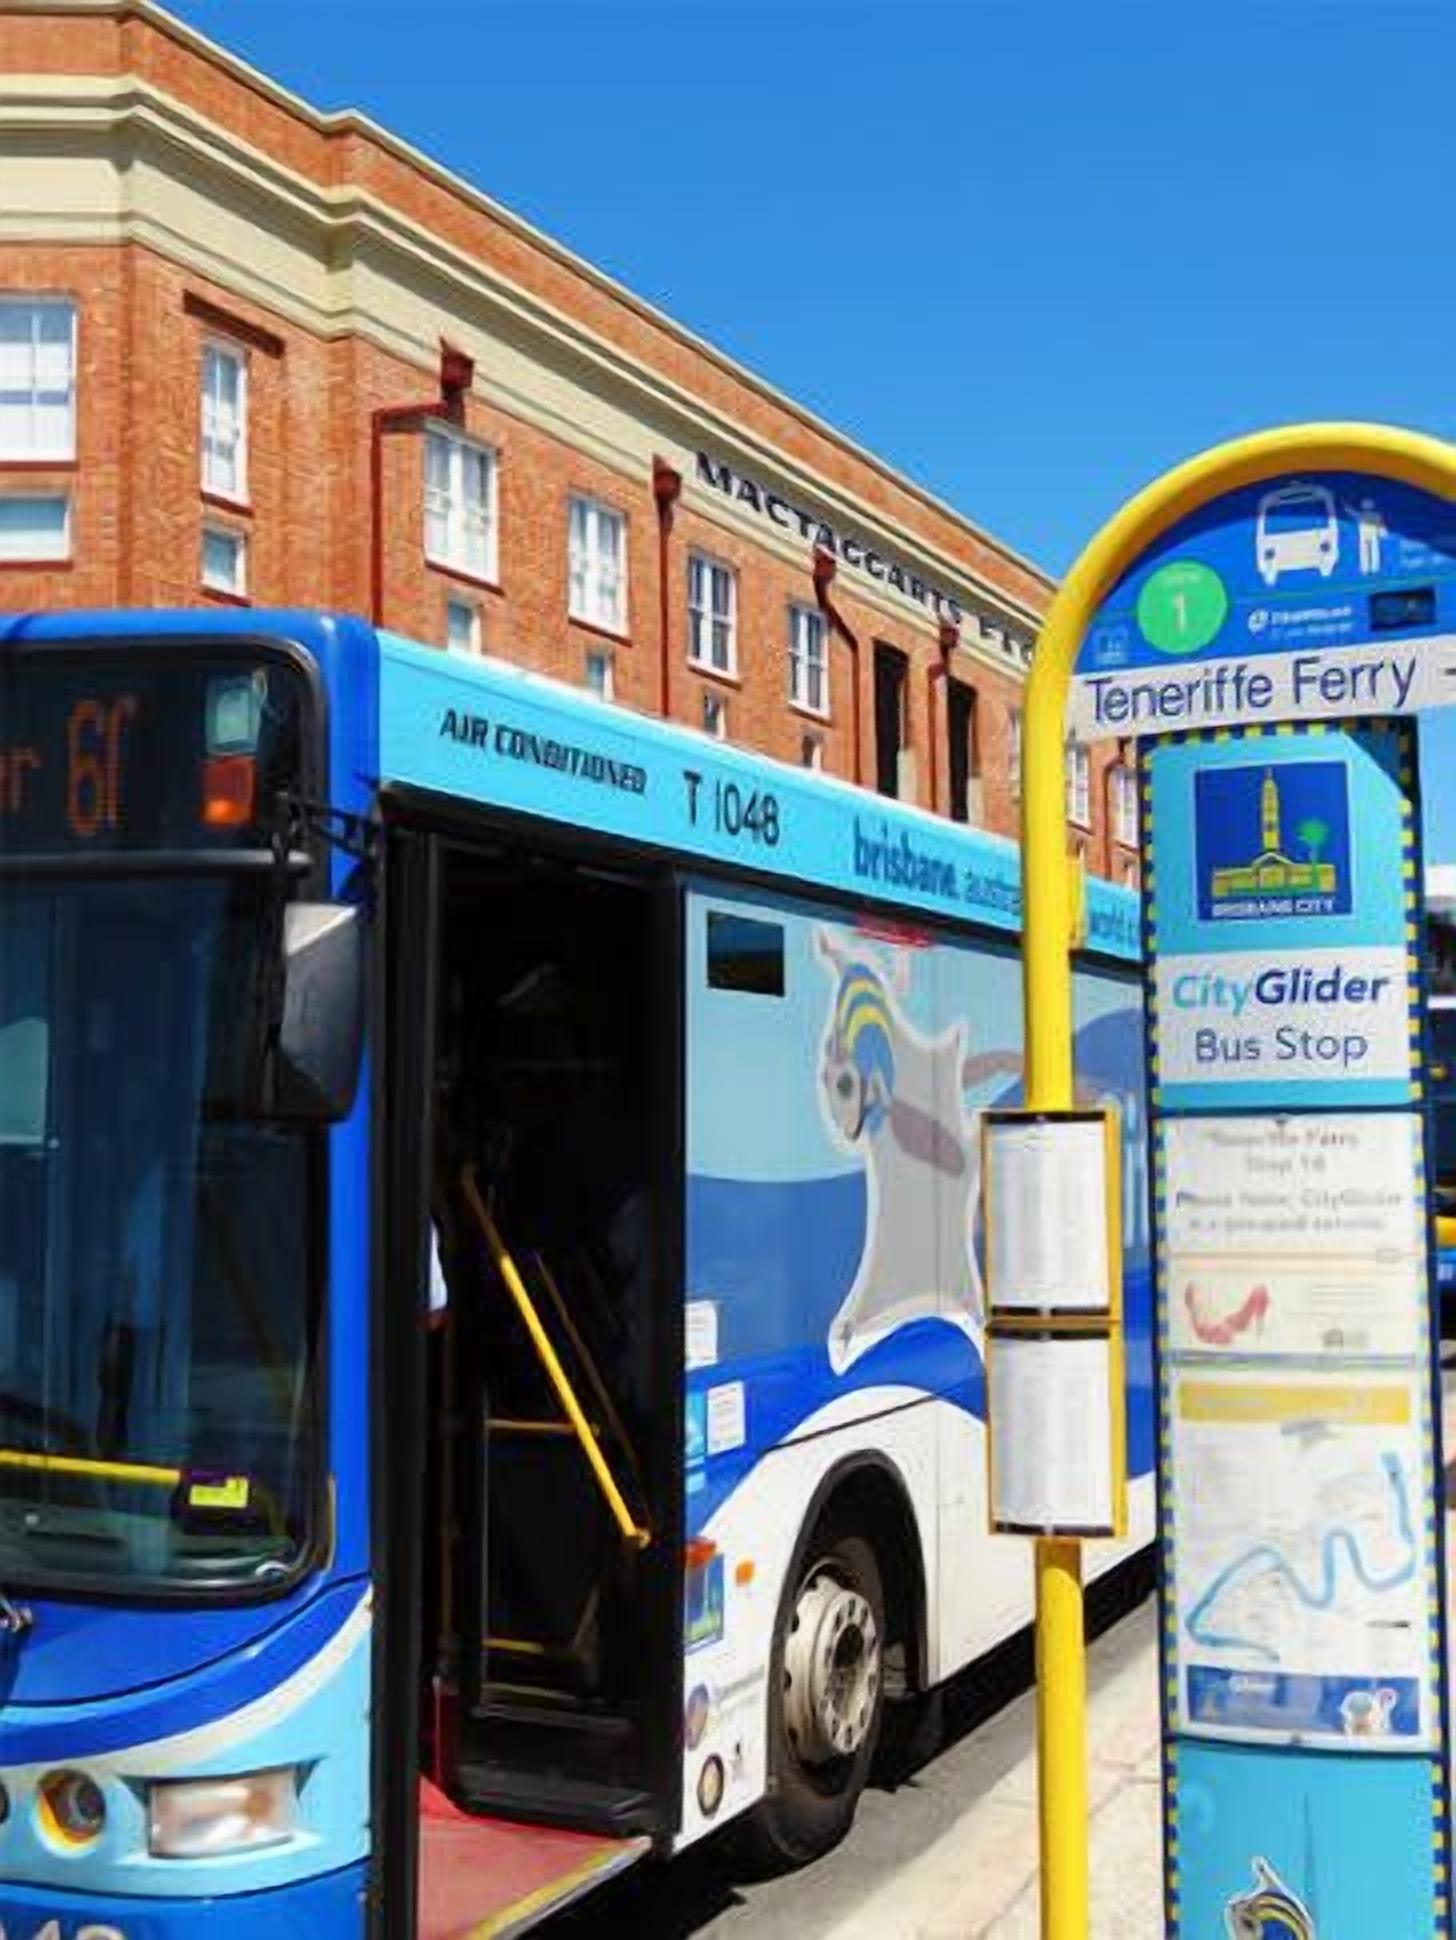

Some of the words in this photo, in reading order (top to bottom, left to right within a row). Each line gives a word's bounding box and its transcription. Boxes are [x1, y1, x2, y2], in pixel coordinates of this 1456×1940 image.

[1173, 592, 1188, 635] 1
[1085, 661, 1273, 723] Teneriffe
[1292, 655, 1417, 710] Ferry
[440, 706, 489, 749] AIR
[495, 723, 648, 796] CONDITIONED
[683, 768, 702, 826] T
[714, 775, 781, 847] 1048
[1195, 1027, 1261, 1063] Bus
[1275, 1024, 1369, 1068] Stop
